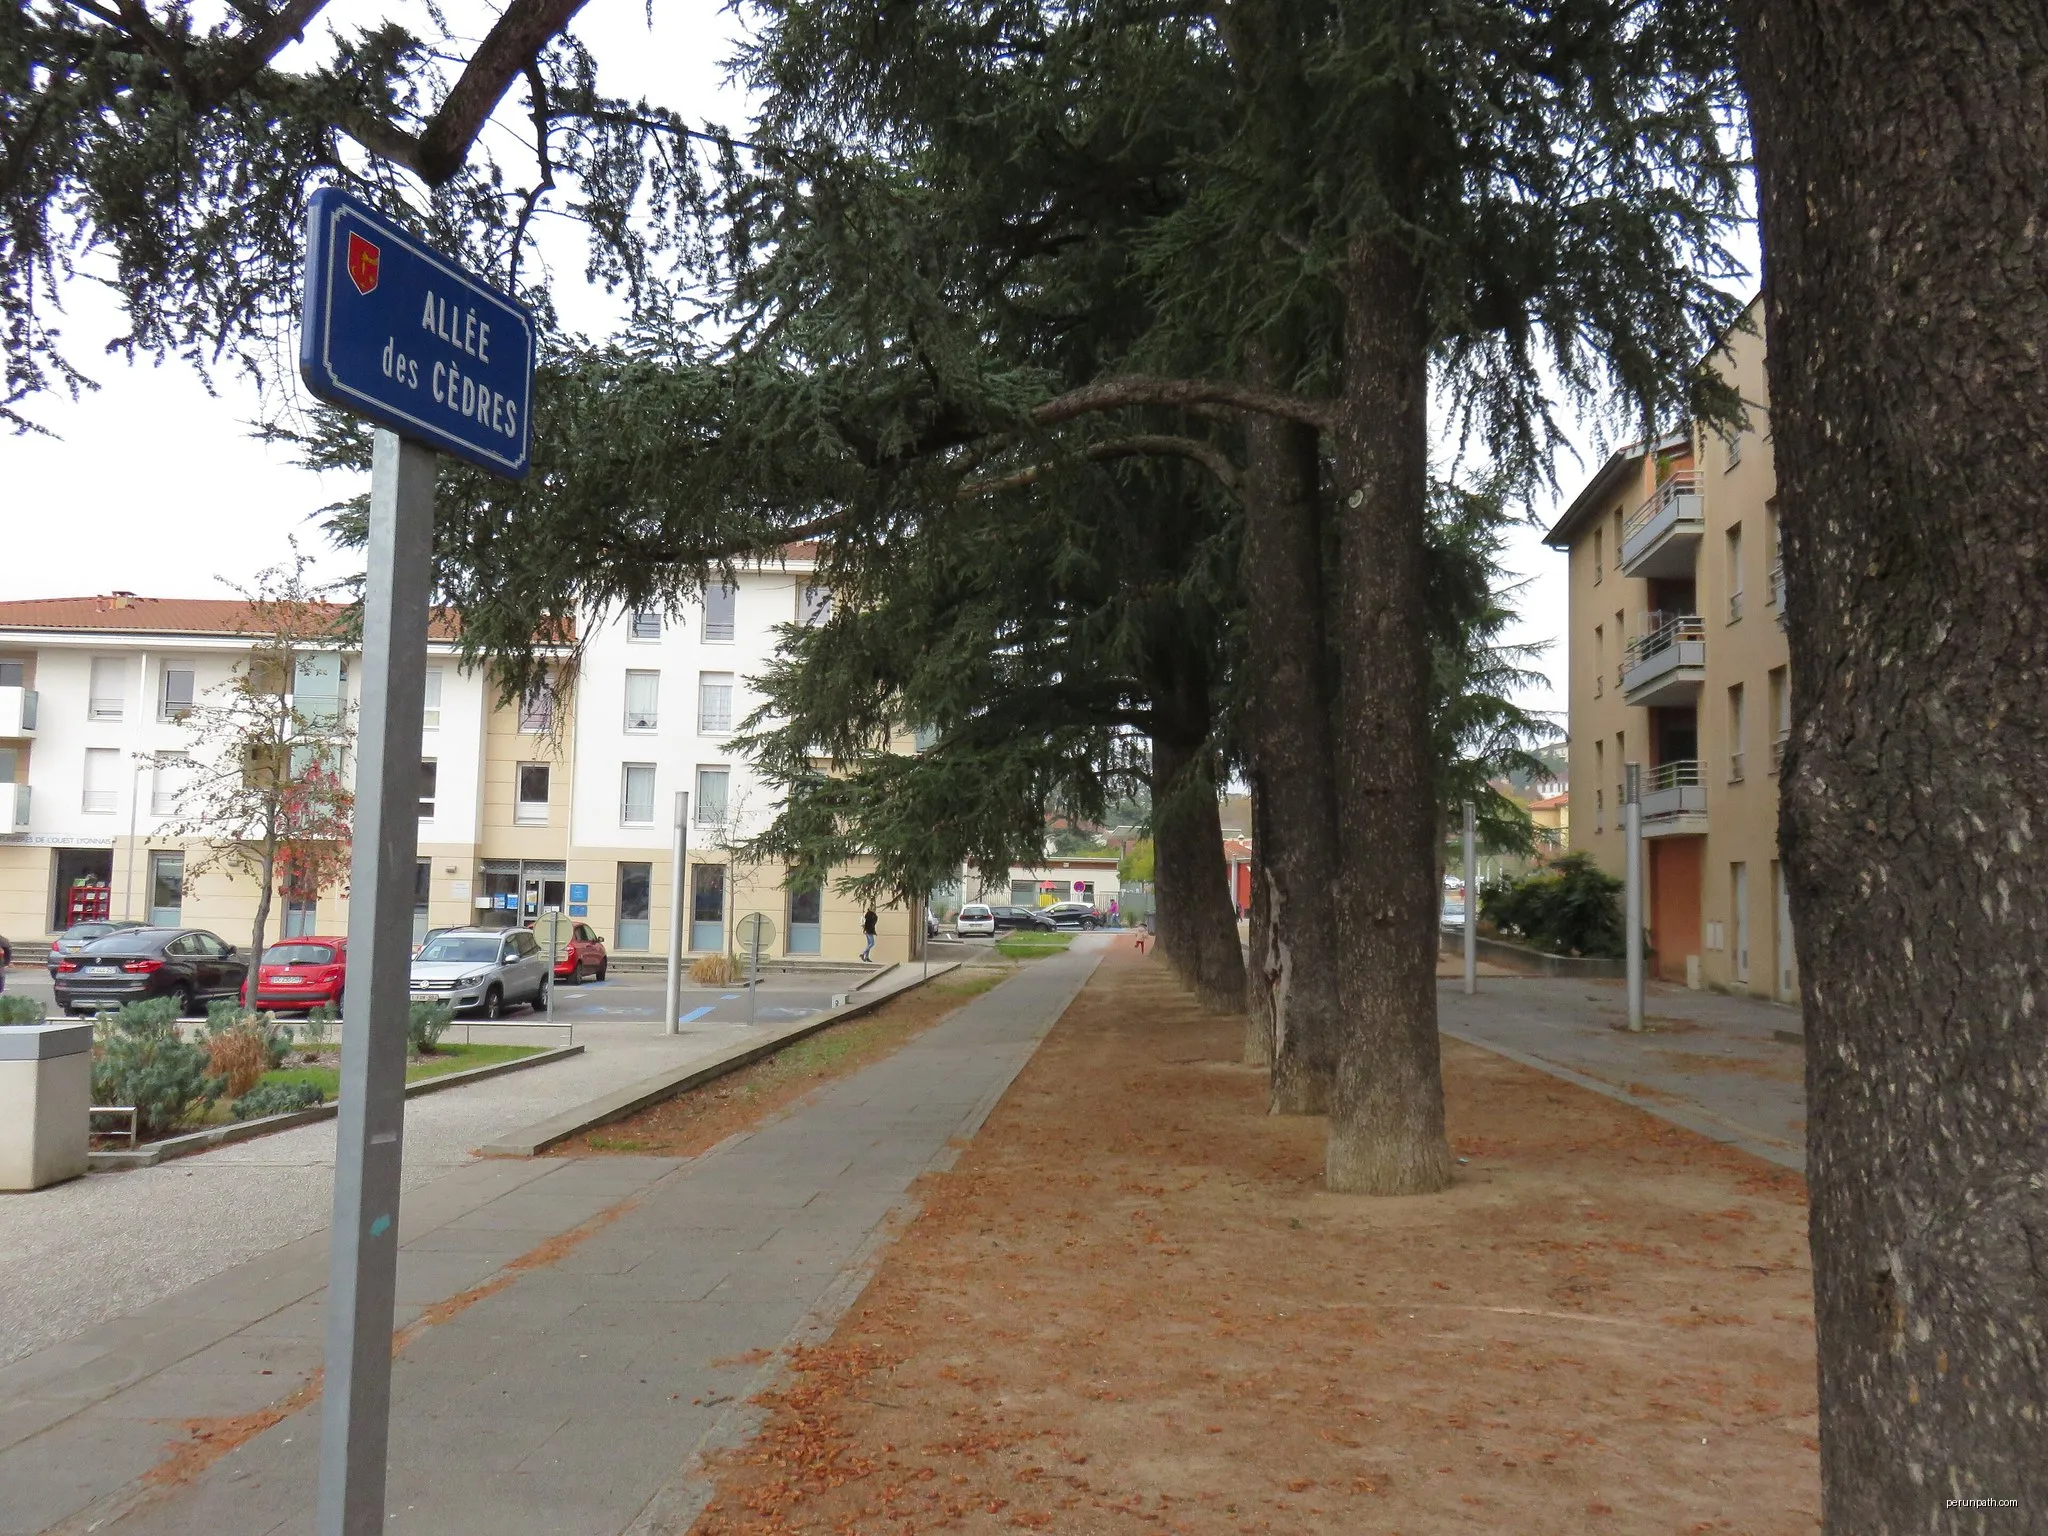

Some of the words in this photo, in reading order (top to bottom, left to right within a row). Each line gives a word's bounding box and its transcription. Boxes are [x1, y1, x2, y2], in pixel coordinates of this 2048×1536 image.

[422, 290, 491, 364] ALLÉE
[382, 336, 419, 390] des
[432, 360, 517, 438] CÈDRES
